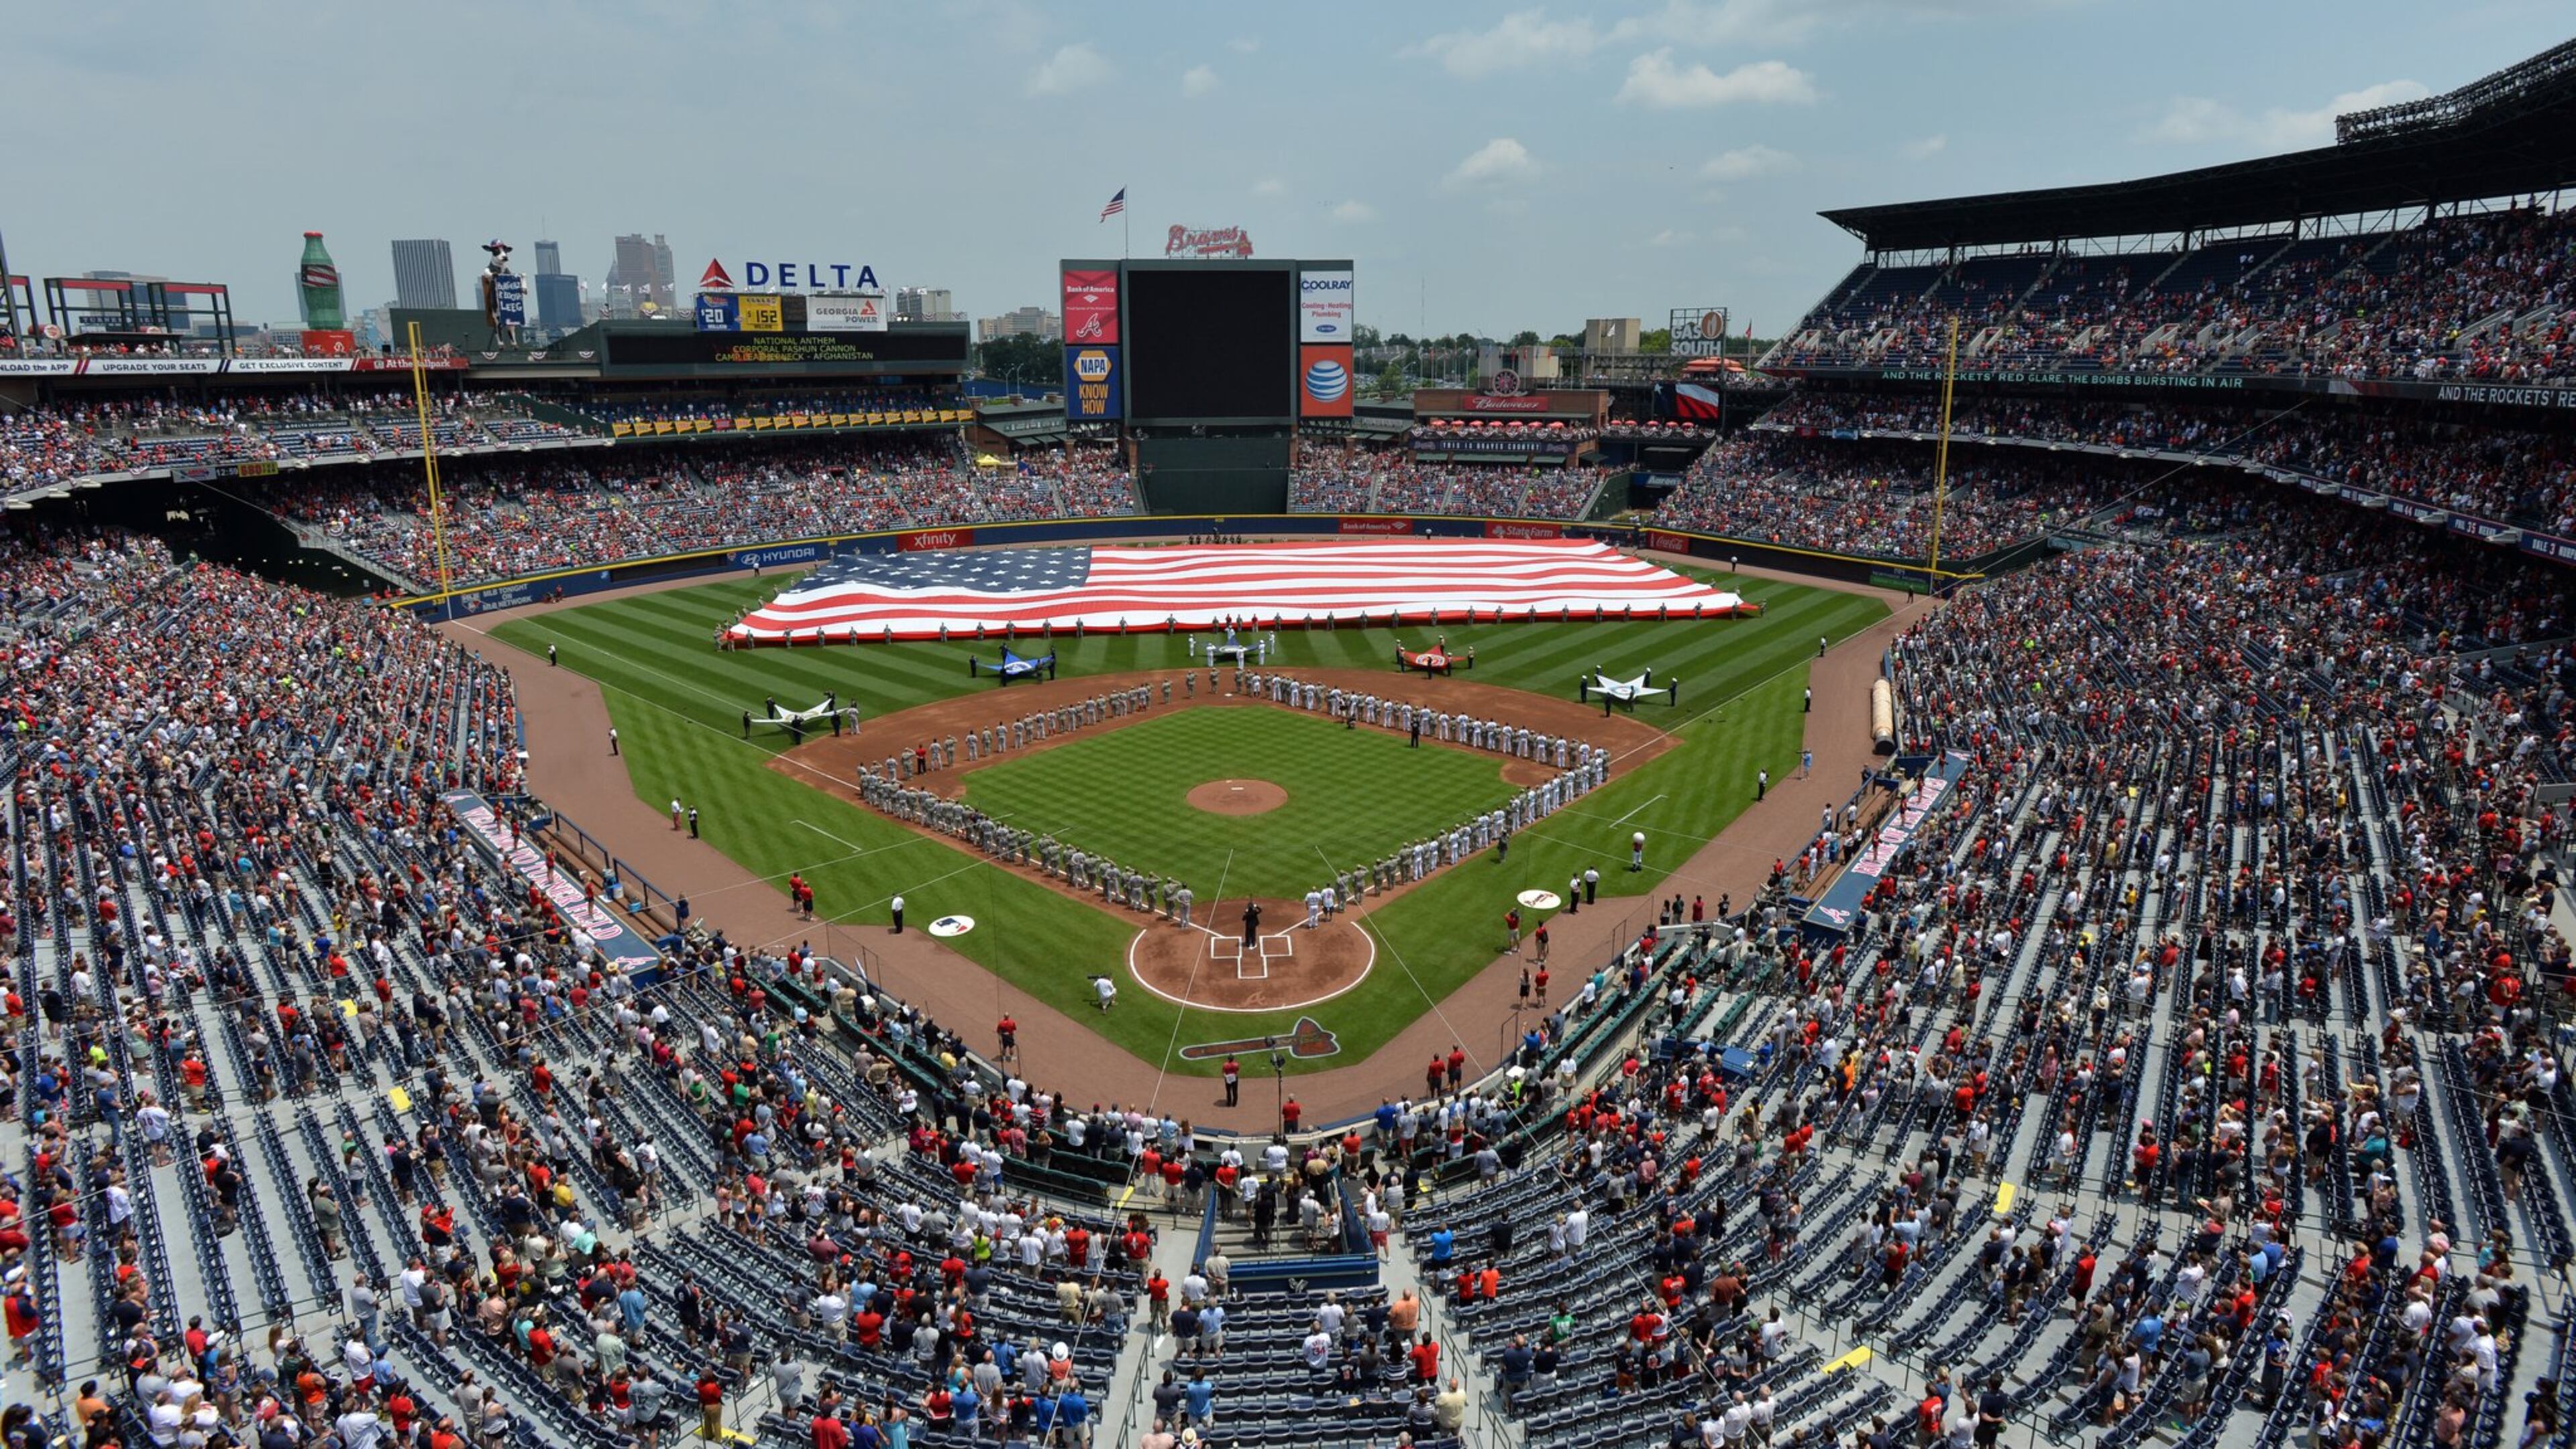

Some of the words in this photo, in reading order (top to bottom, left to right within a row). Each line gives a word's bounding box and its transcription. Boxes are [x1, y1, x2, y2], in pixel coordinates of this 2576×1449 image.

[1166, 224, 1239, 256] Braves
[745, 262, 879, 288] DELTA
[1301, 280, 1352, 290] COOLRAY
[1671, 324, 1701, 339] GAS
[813, 352, 873, 360] AFGHANISTAN
[1670, 341, 1721, 356] SOUTH
[33, 364, 47, 372] the
[386, 359, 397, 368] At
[1080, 358, 1106, 374] NAPA
[1909, 372, 1931, 380] THE
[1998, 373, 2025, 382] RED
[2068, 375, 2088, 384] THE
[2091, 375, 2131, 385] BOMBS
[2135, 376, 2197, 386] BURSTING
[2202, 378, 2214, 387] IN
[2219, 378, 2243, 388] AIR
[1079, 384, 1109, 399] KNOW
[2438, 386, 2461, 400] AND
[2464, 387, 2486, 402] THE
[2489, 388, 2554, 405] ROCKETS'
[1082, 400, 1106, 415] HOW
[1472, 397, 1539, 409] Budweiser
[914, 532, 956, 548] xfinity
[763, 547, 815, 561] HYUNDAI
[498, 584, 529, 594] TONIGHT
[498, 596, 532, 608] NETWORK
[507, 847, 540, 865] TO
[519, 860, 585, 908] TURNER
[564, 902, 623, 940] FIELD
